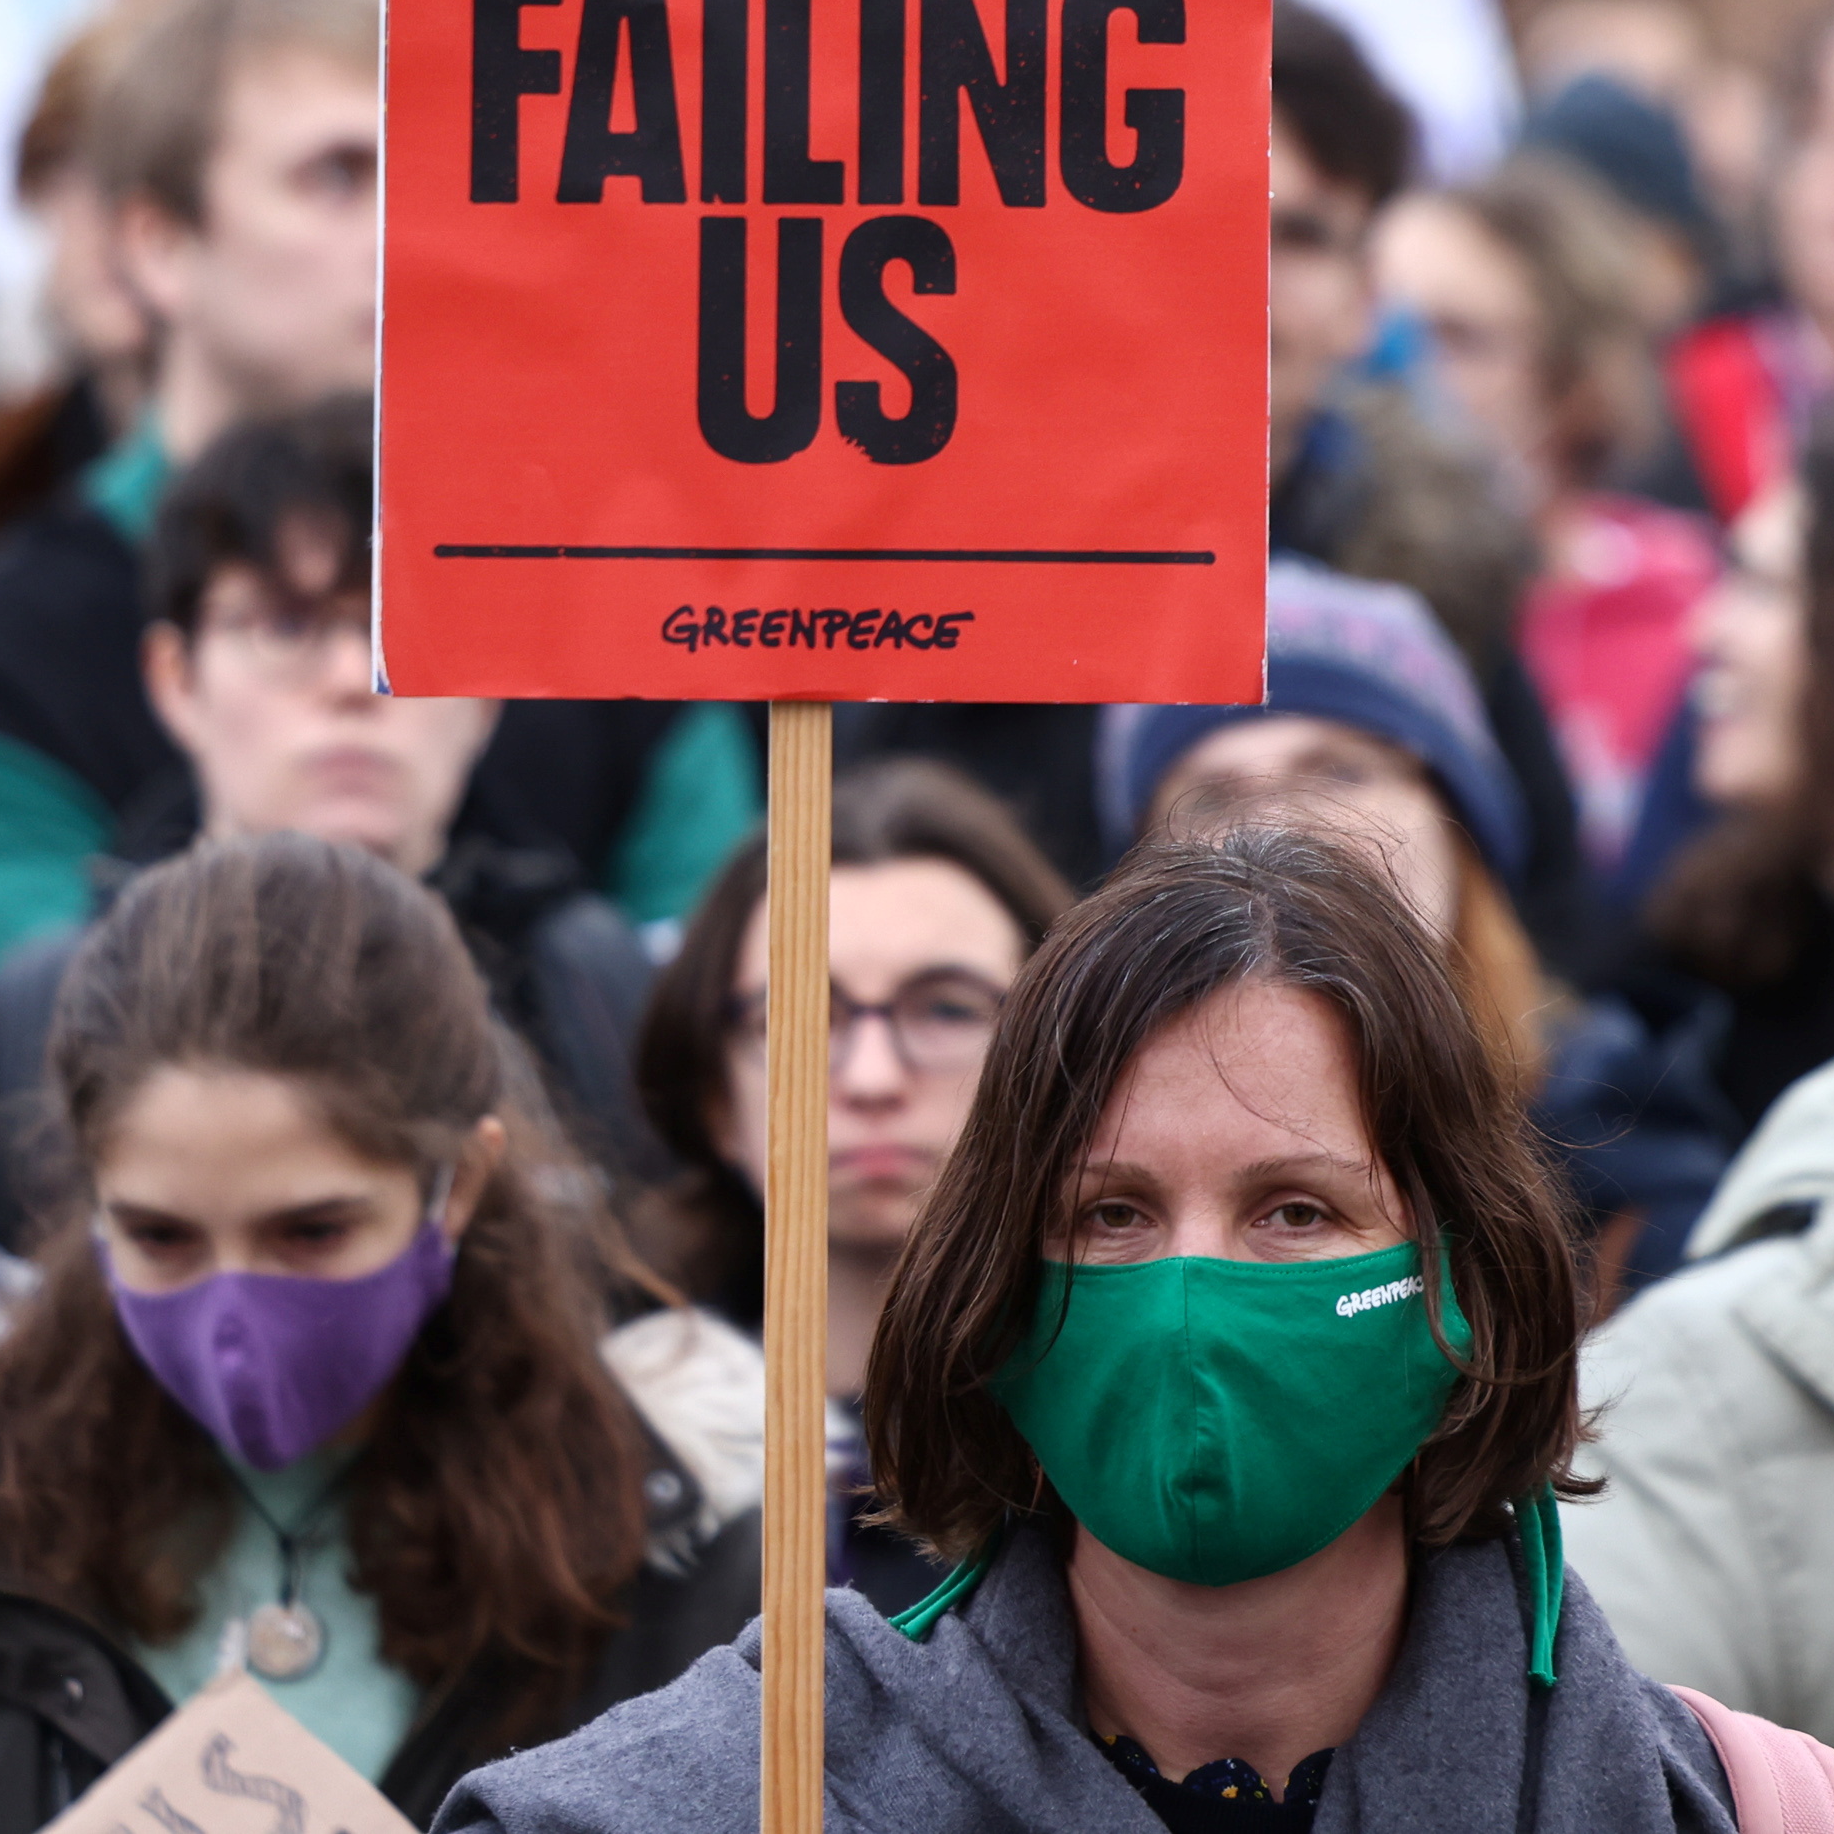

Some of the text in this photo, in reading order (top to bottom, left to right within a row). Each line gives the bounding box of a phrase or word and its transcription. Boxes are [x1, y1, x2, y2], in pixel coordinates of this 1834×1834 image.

[696, 215, 958, 466] US
[661, 604, 975, 653] GREENPEACE
[1335, 1275, 1425, 1318] GREENPEAC
